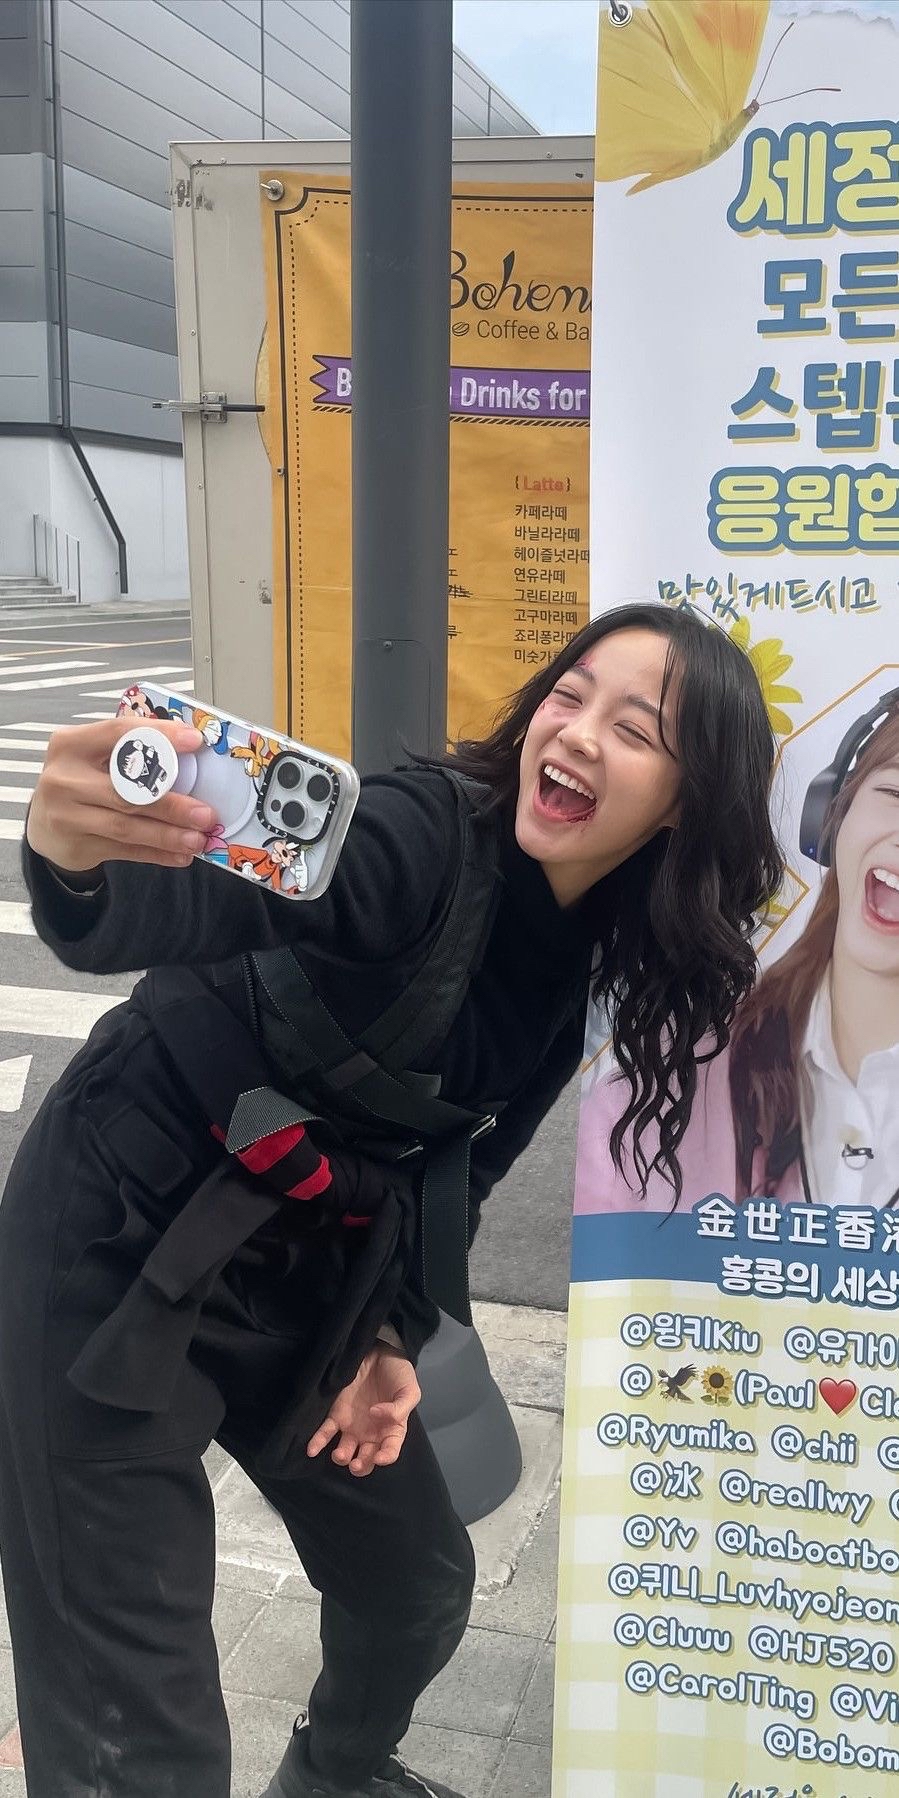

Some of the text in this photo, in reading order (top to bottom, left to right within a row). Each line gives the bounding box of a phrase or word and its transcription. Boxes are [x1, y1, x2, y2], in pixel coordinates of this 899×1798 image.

[732, 124, 899, 230] 세정
[450, 250, 592, 313] Bohem
[757, 252, 899, 341] 모든
[476, 319, 539, 340] Coffee
[546, 321, 558, 340] &
[460, 377, 586, 411] Drinks for
[727, 359, 899, 450] 스텝
[515, 504, 568, 521] 카페라떼
[514, 526, 580, 542] 바닐라라떼
[514, 567, 566, 584] 연유라떼
[514, 589, 577, 605] 그린티라떼
[514, 609, 577, 625] 고구마라떼
[720, 1254, 819, 1298] 홍콩의
[597, 1413, 755, 1453] @Ryumika
[771, 1425, 857, 1464] @chii
[631, 1461, 700, 1498] @冰
[623, 1514, 696, 1549] @Yv
[614, 1613, 895, 1674] @Cluuu @HJ520
[625, 1660, 815, 1719] @CarolTing
